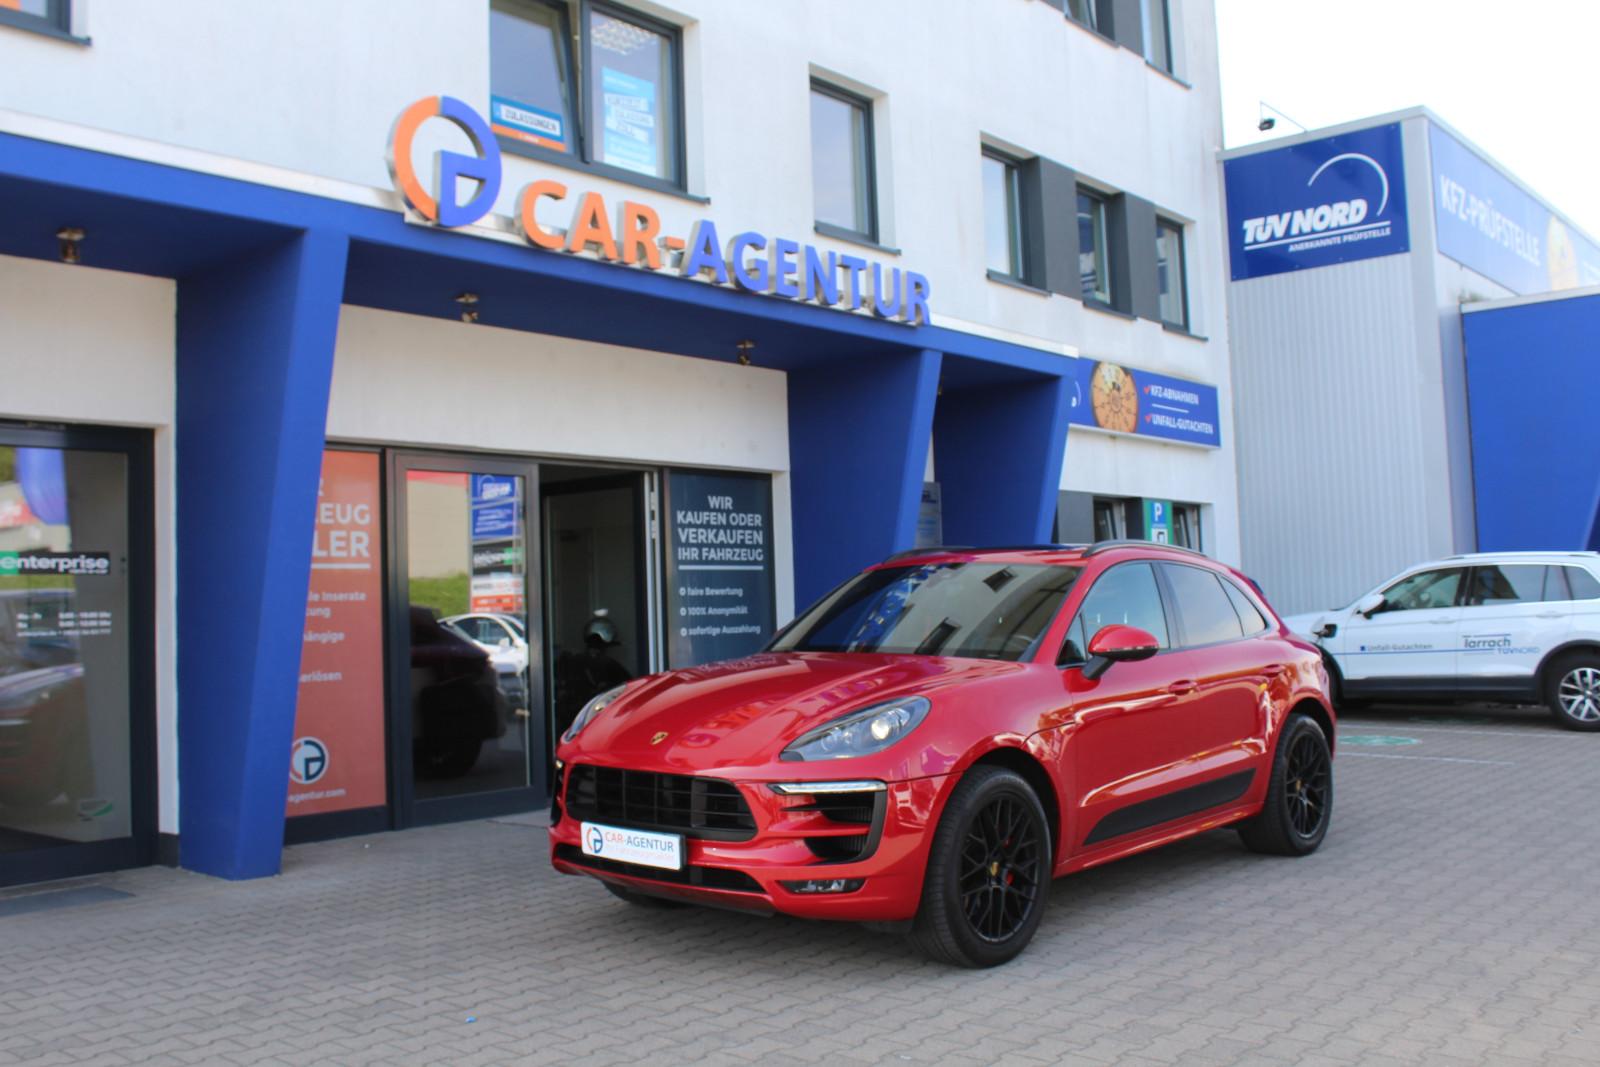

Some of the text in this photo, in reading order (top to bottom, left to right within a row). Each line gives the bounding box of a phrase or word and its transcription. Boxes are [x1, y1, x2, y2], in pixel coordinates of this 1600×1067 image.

[1290, 198, 1369, 236] NORD
[1440, 174, 1541, 267] KFZ-PRÜFSTELLE
[1288, 226, 1391, 253] ANERKANNTE PRÜFSTELLE
[515, 180, 931, 325] CAR-AGENTUR
[1150, 384, 1200, 405] KFZ-ABNAHMEN
[1151, 413, 1214, 435] UNFALL-GUTACHTEN
[707, 495, 733, 510] WIR
[1154, 502, 1163, 522] P
[676, 510, 762, 527] KAUFEN ODER
[677, 528, 764, 545] VERKAUFEN
[0, 554, 109, 573] enterprise
[678, 547, 764, 561] IHR FAHRZEUG
[321, 591, 367, 602] Inserate
[705, 586, 744, 598] Bewertung
[605, 831, 674, 852] CAR-AGENTUR
